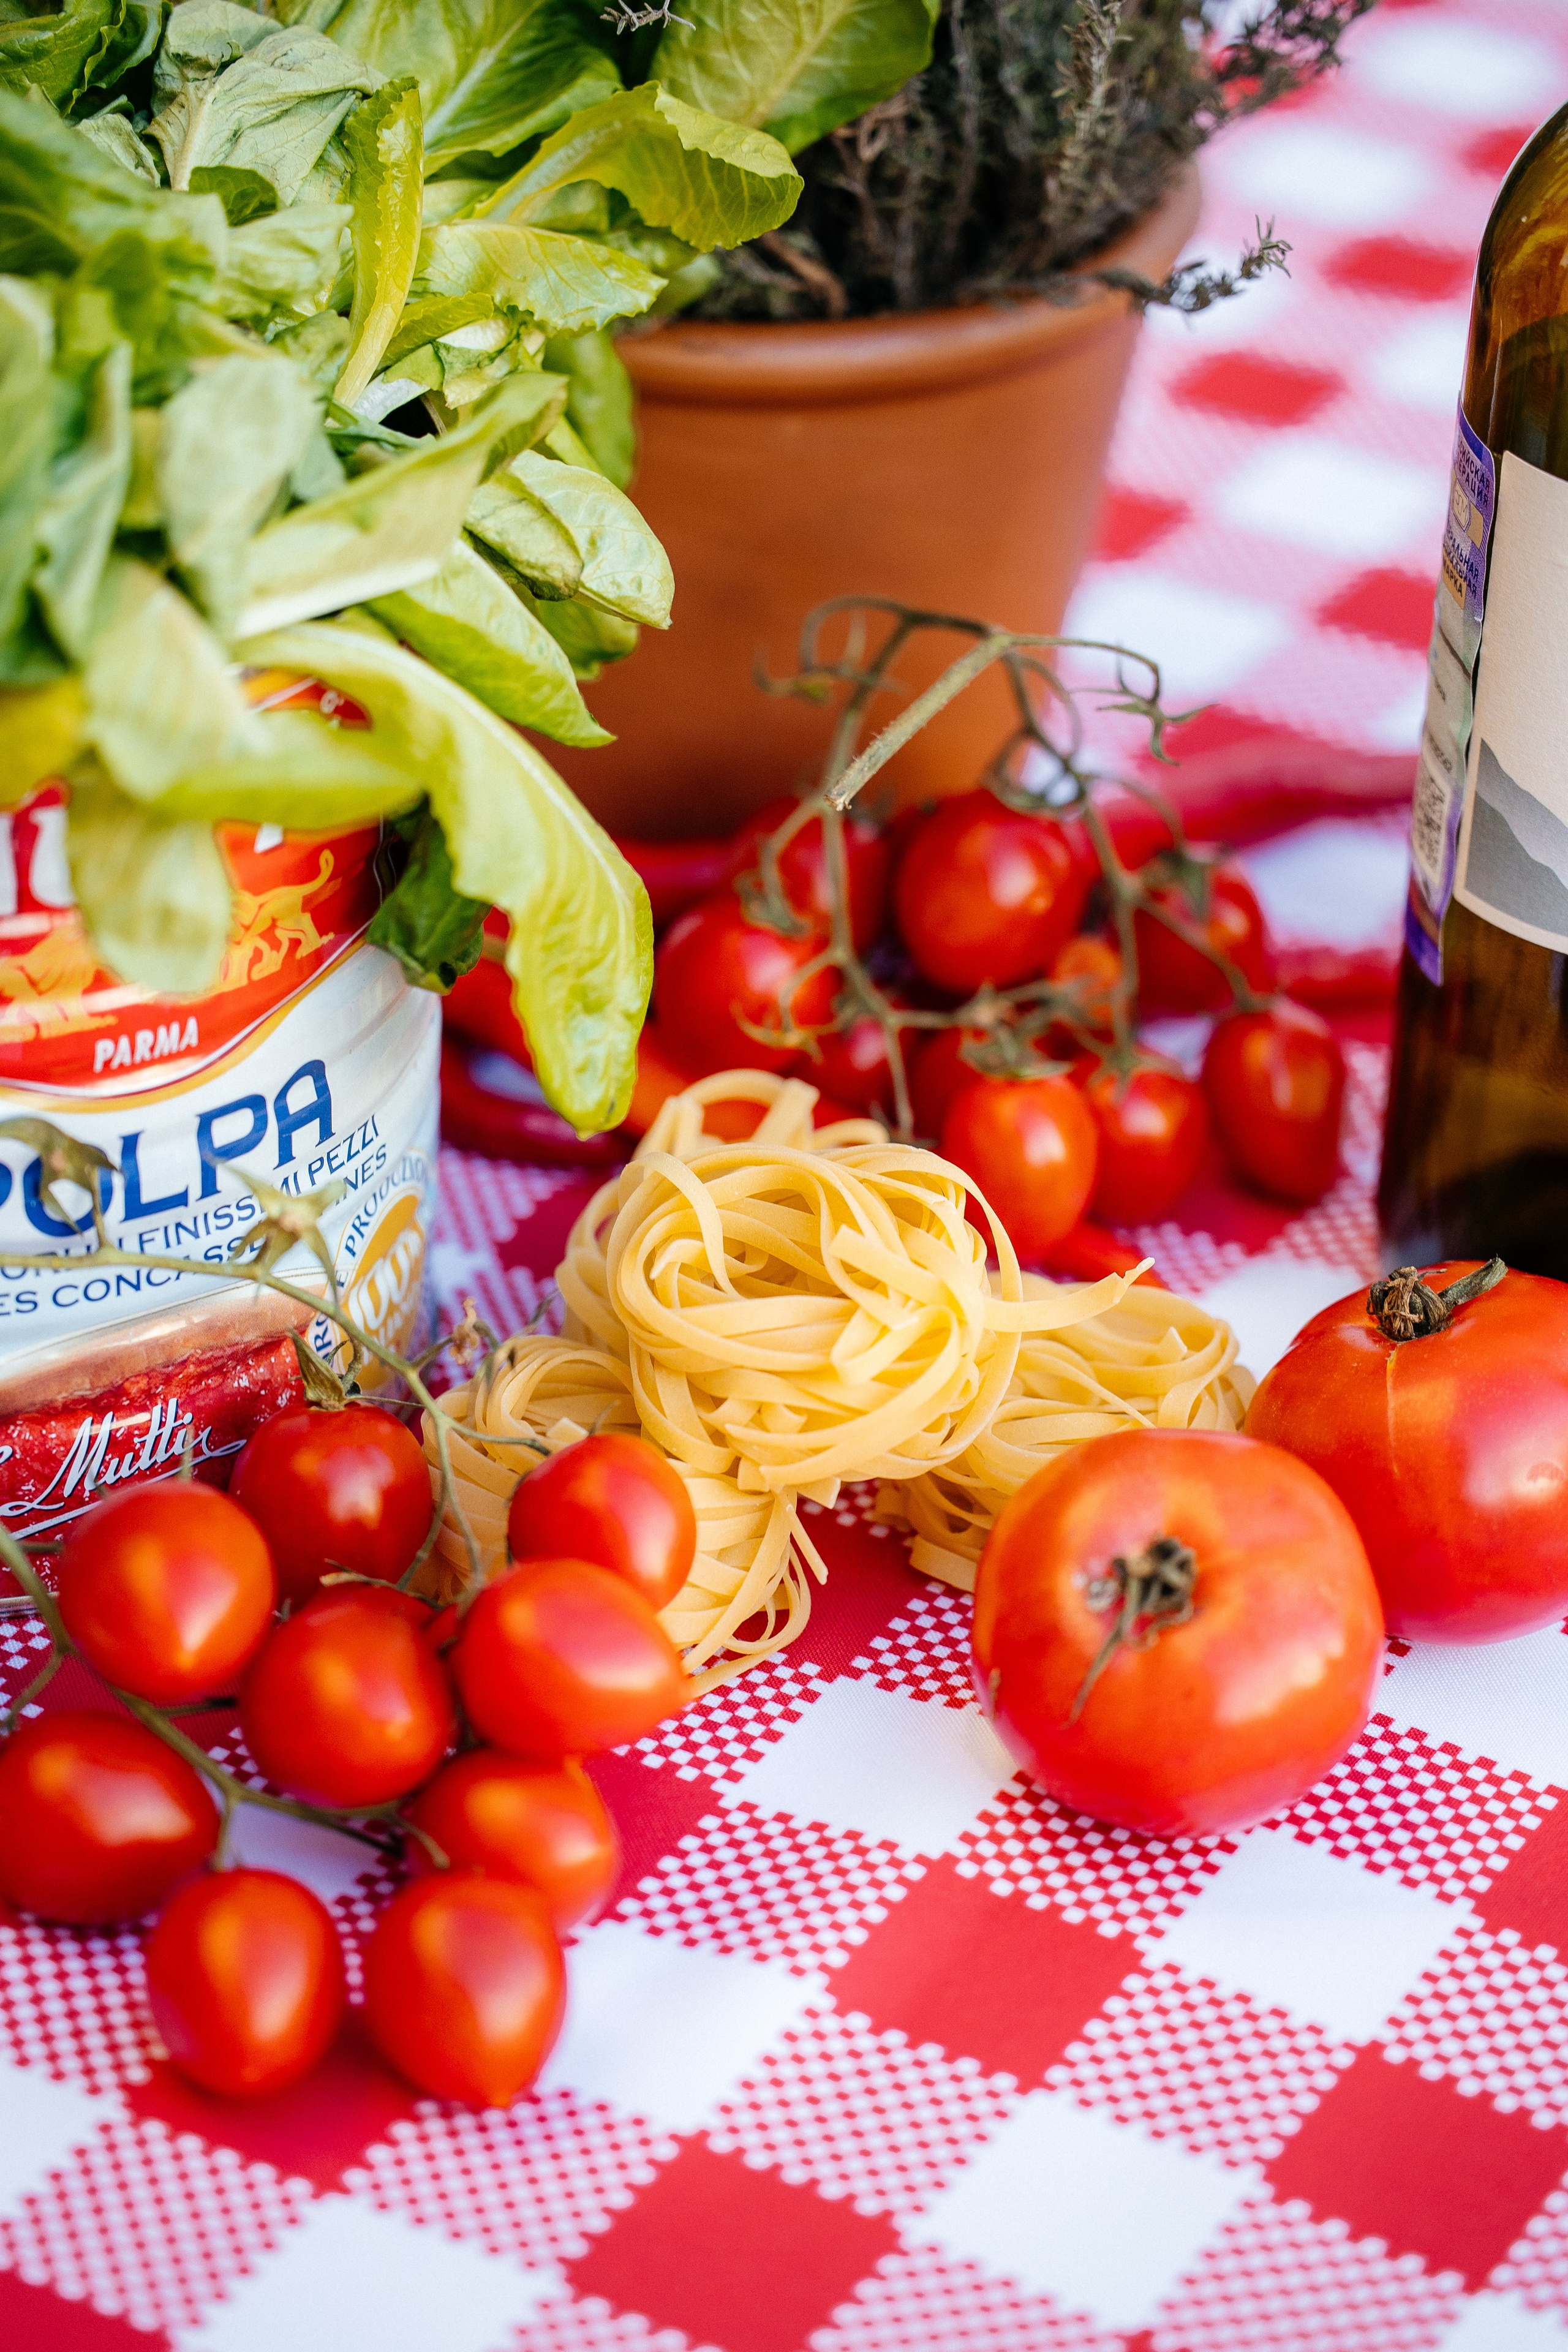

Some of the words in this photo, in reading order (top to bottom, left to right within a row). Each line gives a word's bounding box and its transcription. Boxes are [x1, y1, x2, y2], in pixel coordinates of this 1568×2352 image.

[92, 1016, 199, 1074] PARMA
[307, 1114, 380, 1187] PEZZI
[0, 1396, 247, 1517] Mutti
